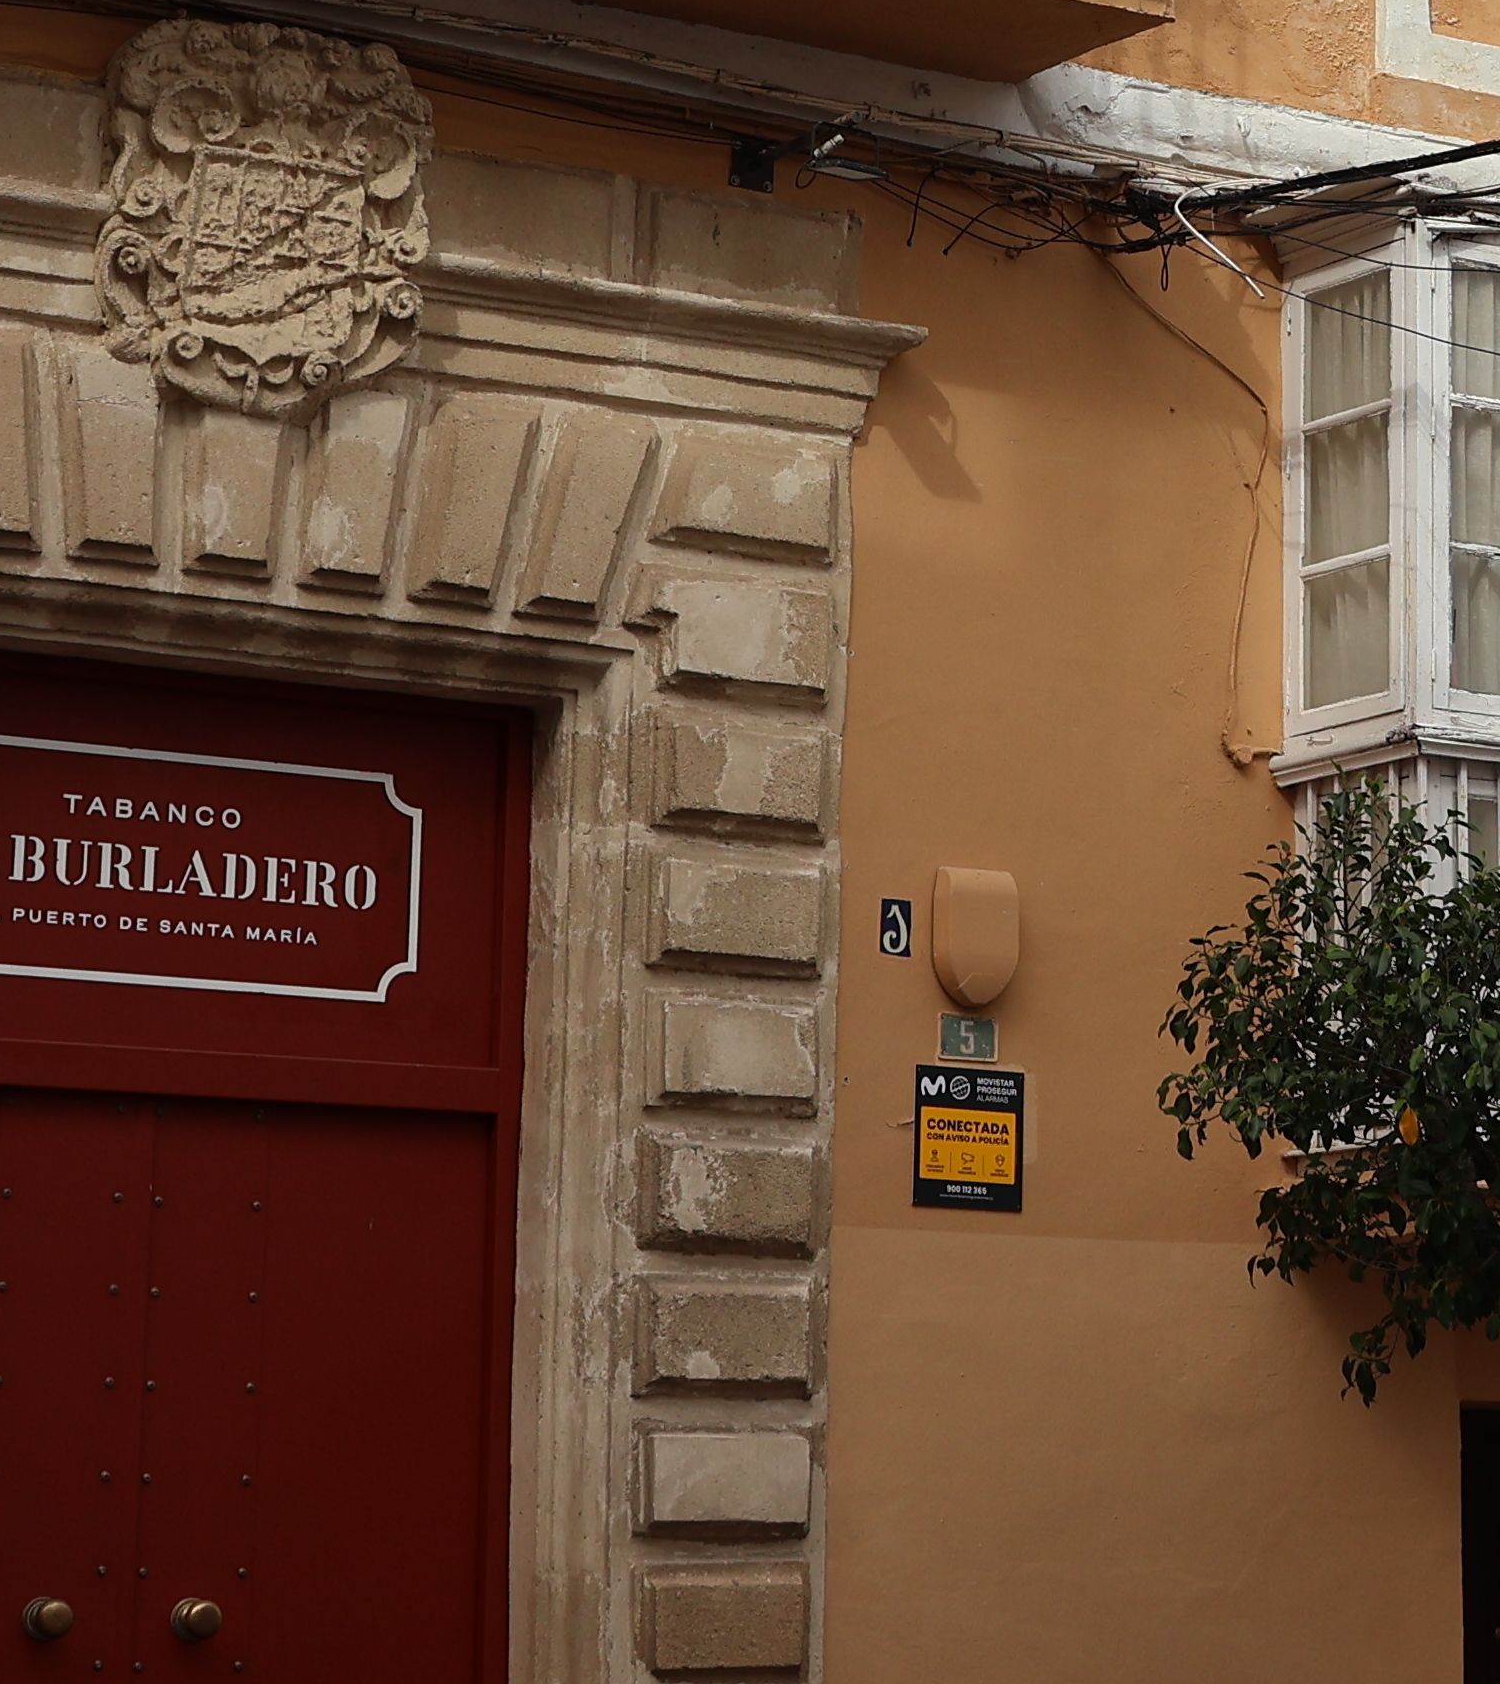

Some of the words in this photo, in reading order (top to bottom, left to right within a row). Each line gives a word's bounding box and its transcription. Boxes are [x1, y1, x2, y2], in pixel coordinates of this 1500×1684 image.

[62, 793, 242, 829] TABANCO
[8, 834, 377, 911] BURLADERO
[12, 907, 107, 928] PUERTO
[119, 916, 148, 932] DE
[159, 919, 235, 939] SANTA
[246, 926, 318, 945] MARÍA
[959, 1020, 975, 1055] 5
[976, 1077, 1015, 1088] MOVISTAR
[976, 1086, 1018, 1097] PROSEGUR
[976, 1095, 1009, 1104] ALARMAS
[926, 1118, 1010, 1136] CONECTADA
[926, 1132, 945, 1141] CON
[946, 1134, 970, 1143] AVISO
[978, 1135, 1009, 1146] POLICÍA
